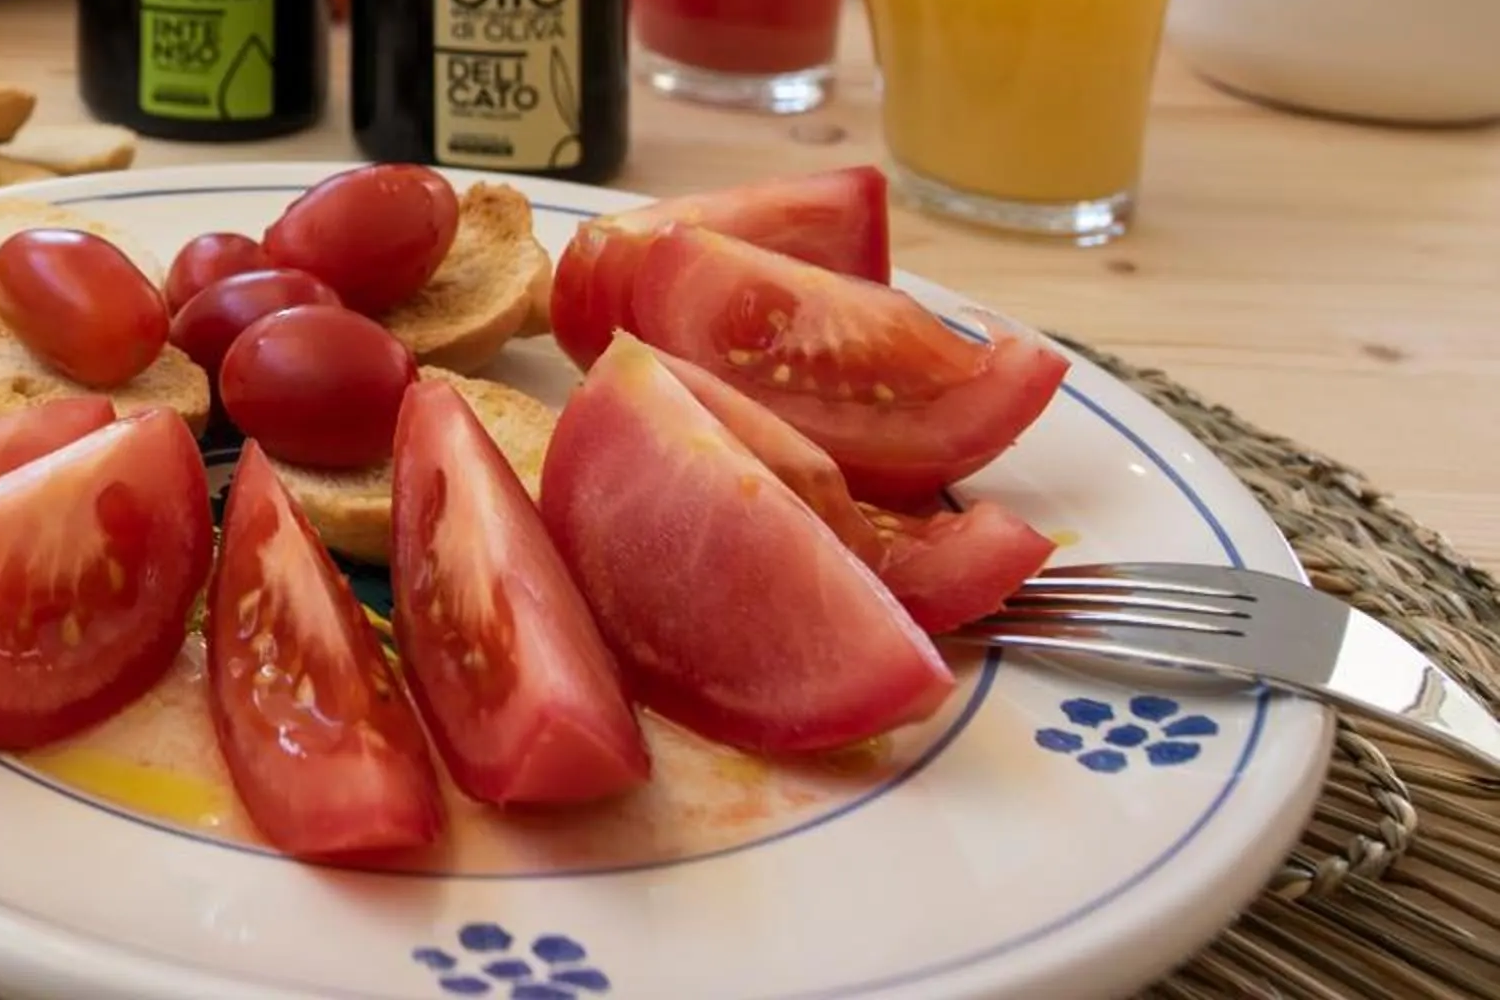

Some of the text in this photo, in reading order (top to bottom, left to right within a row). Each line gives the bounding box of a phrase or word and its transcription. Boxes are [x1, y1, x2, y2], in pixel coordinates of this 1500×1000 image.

[483, 20, 566, 42] OLIVA
[448, 58, 524, 85] DELI
[447, 83, 540, 111] CATO
